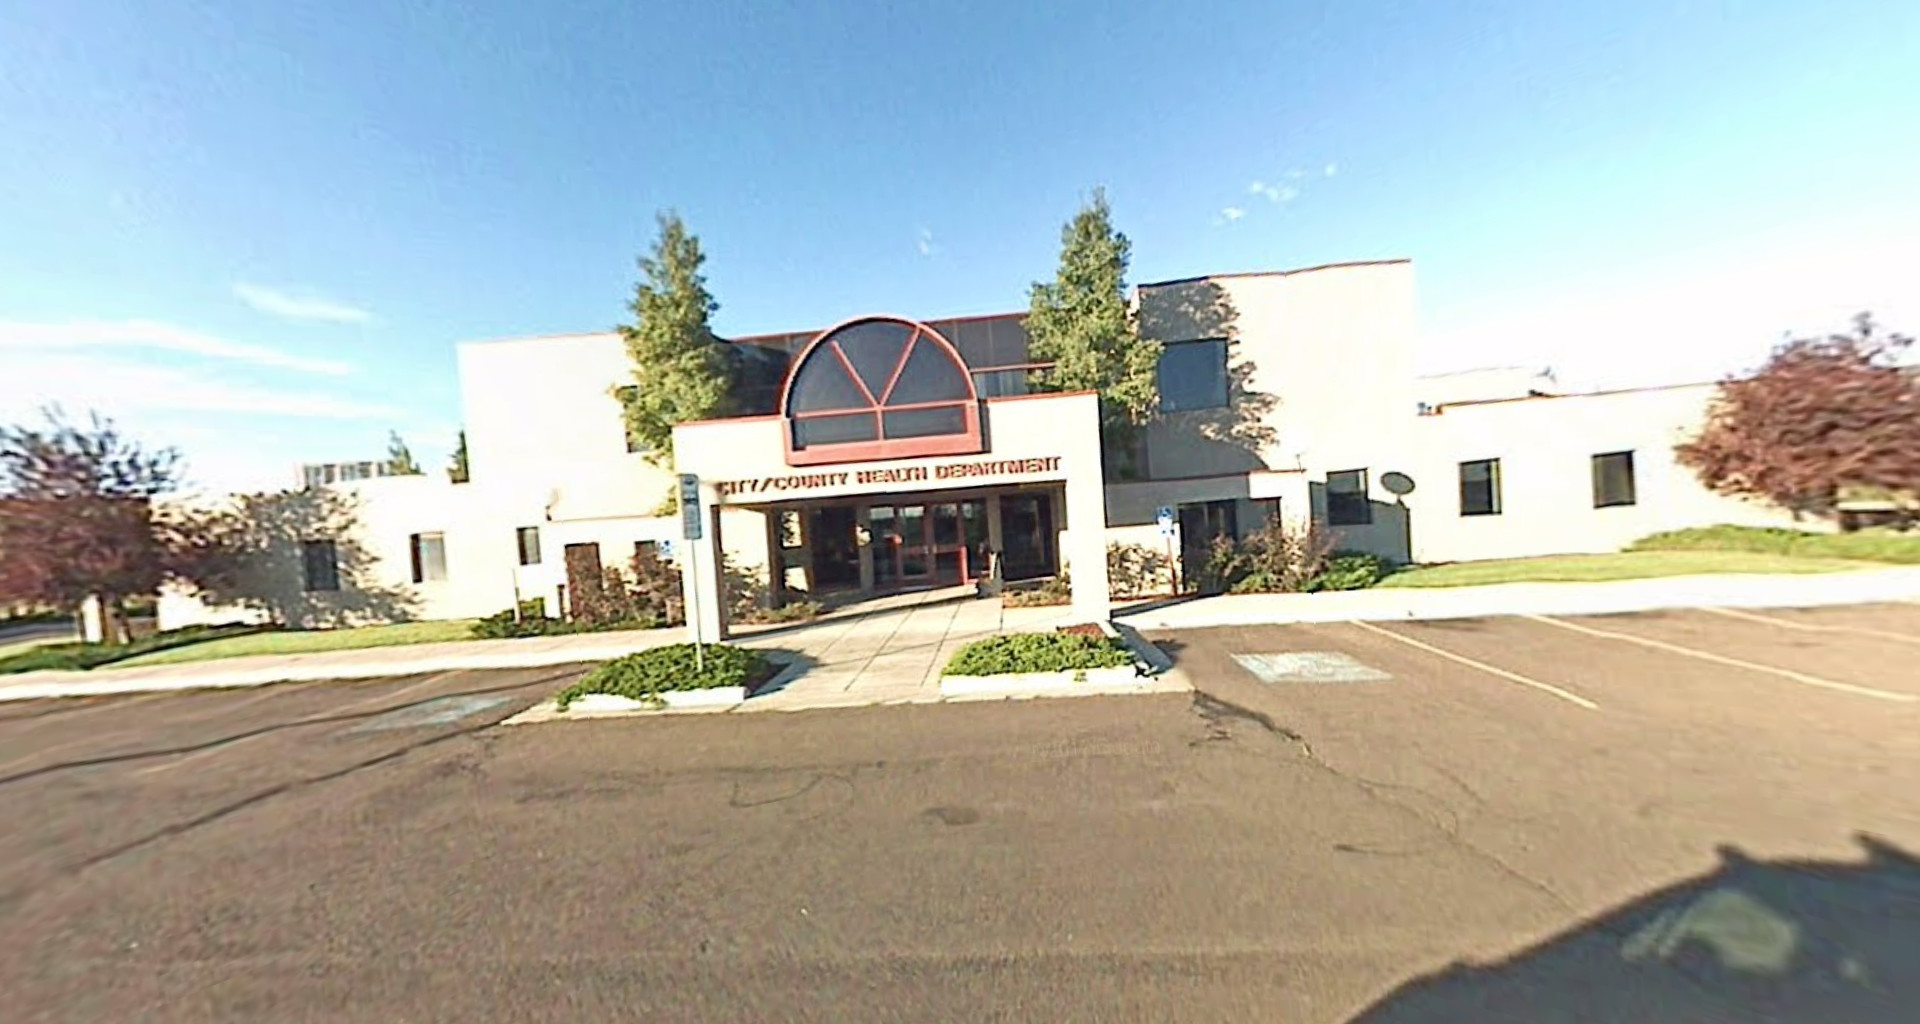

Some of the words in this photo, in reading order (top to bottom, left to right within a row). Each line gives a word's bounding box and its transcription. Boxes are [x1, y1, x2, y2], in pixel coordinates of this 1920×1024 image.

[716, 472, 848, 496] CITY/COUNTY
[857, 466, 927, 484] HEALTH
[935, 456, 1062, 479] DEPARTMENT
